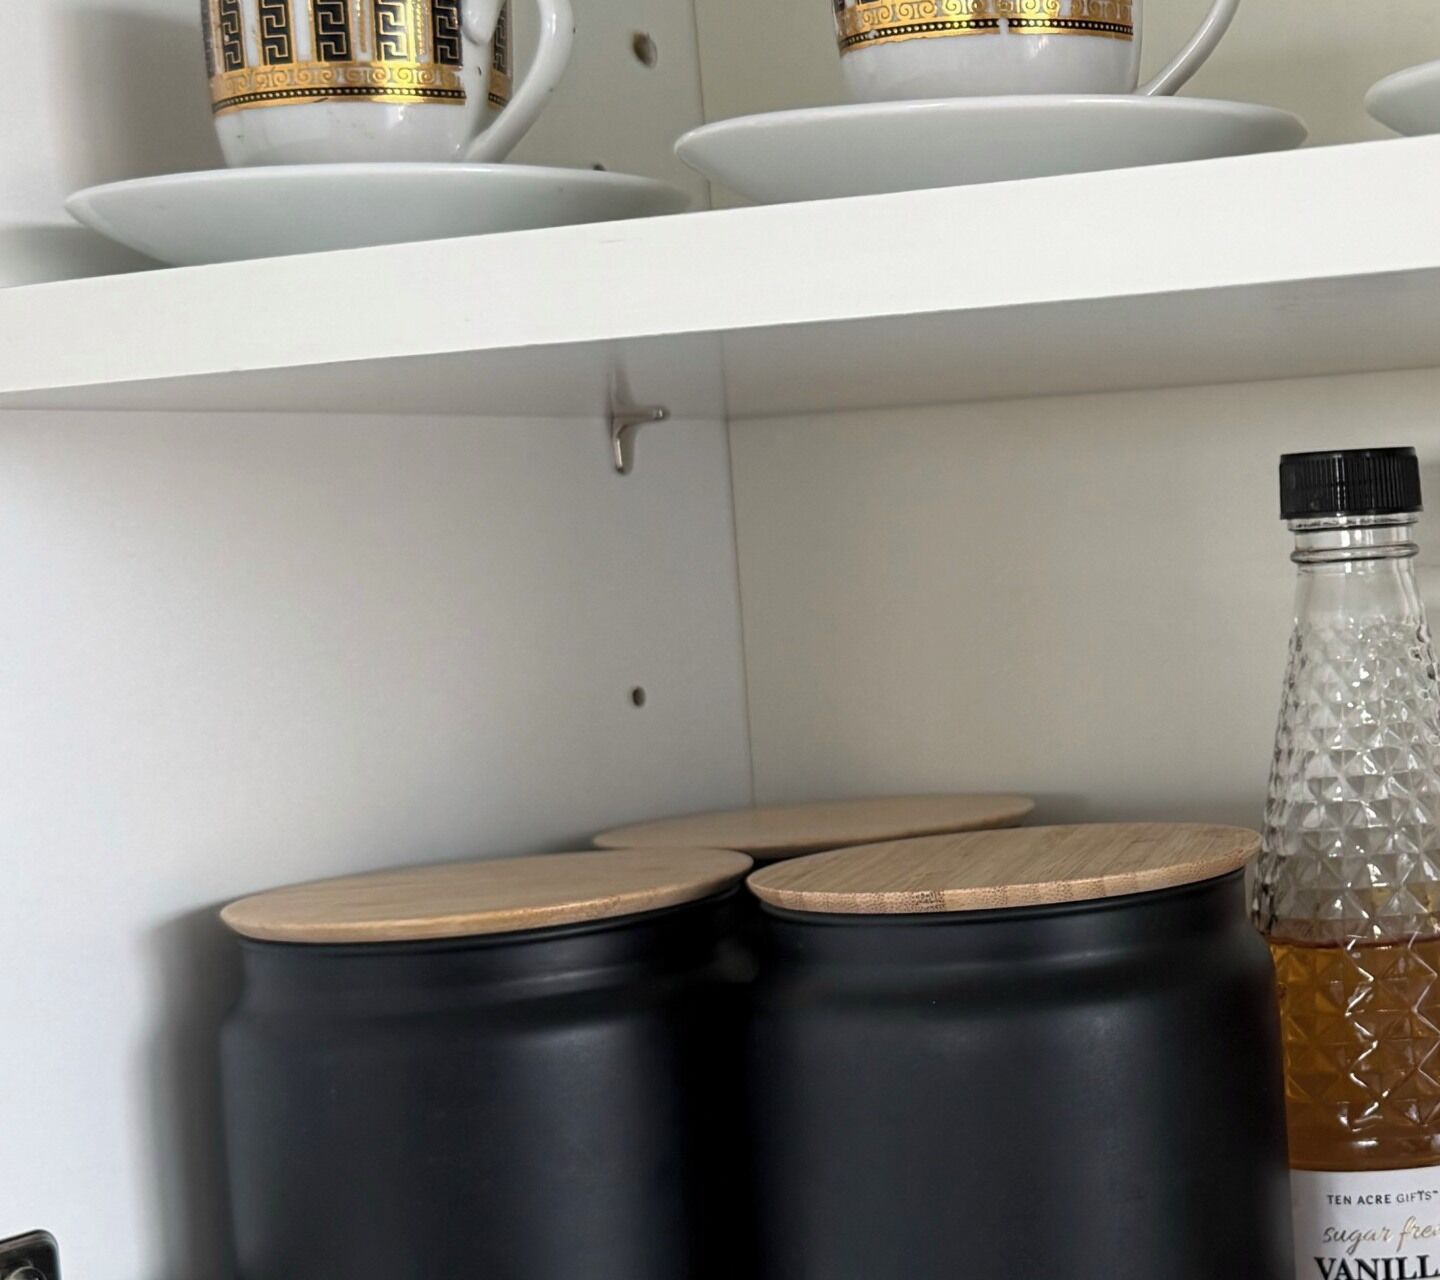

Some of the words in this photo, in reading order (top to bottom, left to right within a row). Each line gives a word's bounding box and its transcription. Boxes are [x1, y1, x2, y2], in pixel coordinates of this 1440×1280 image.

[1326, 1194, 1352, 1206] TEN
[1356, 1193, 1392, 1206] ACRE
[1322, 1226, 1392, 1256] sugar
